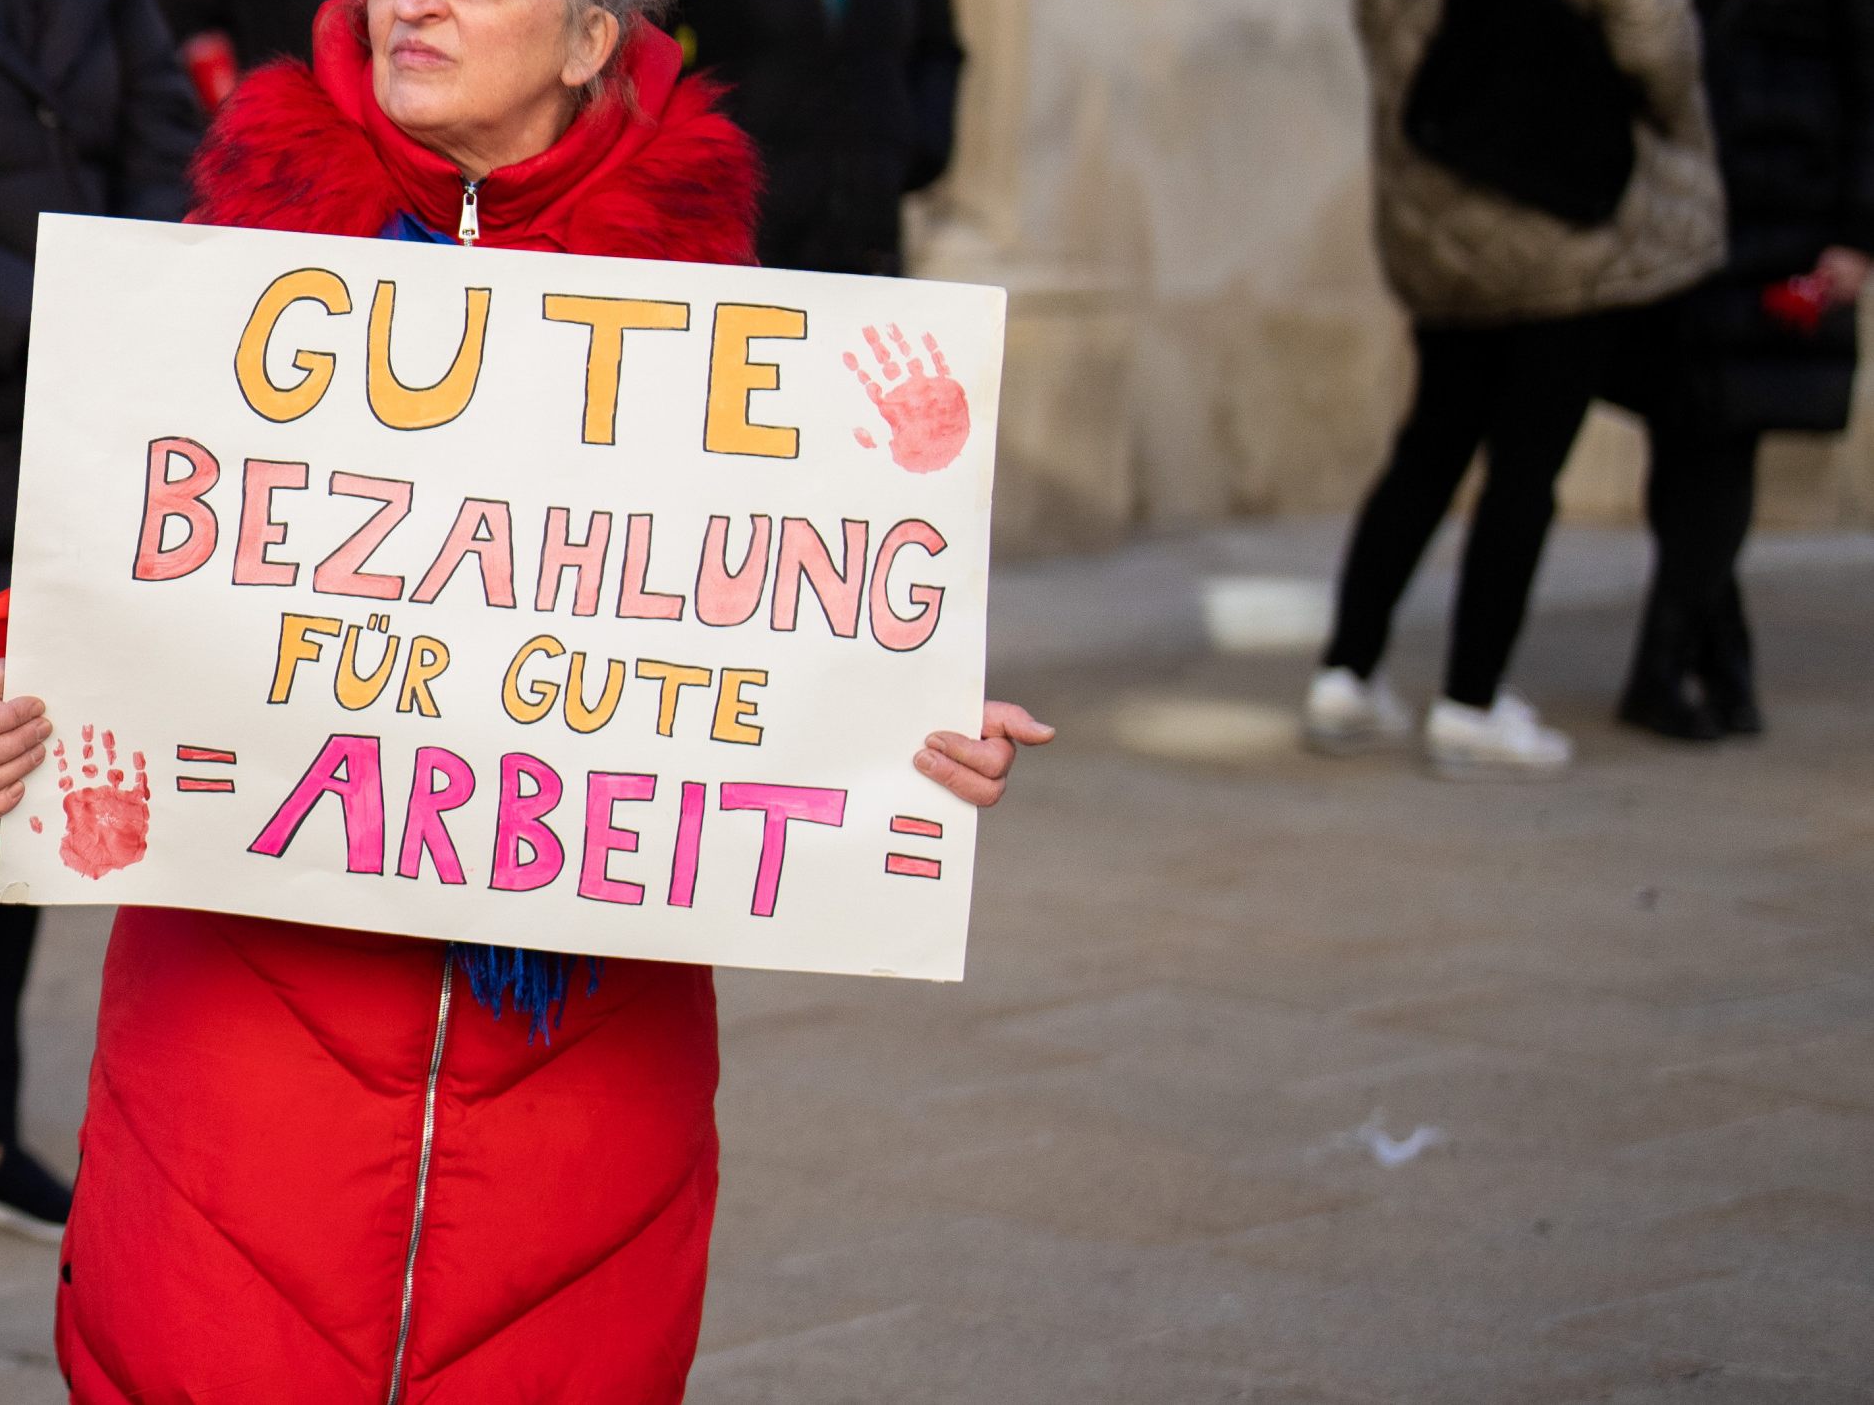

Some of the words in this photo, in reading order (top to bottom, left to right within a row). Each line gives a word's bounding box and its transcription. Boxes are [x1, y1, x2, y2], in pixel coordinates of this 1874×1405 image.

[234, 266, 808, 460] GUTE
[131, 436, 948, 653] BEZAHLUNG
[266, 612, 451, 719] FÜR
[501, 634, 770, 747] GUTE
[247, 733, 848, 919] ARBEIT
